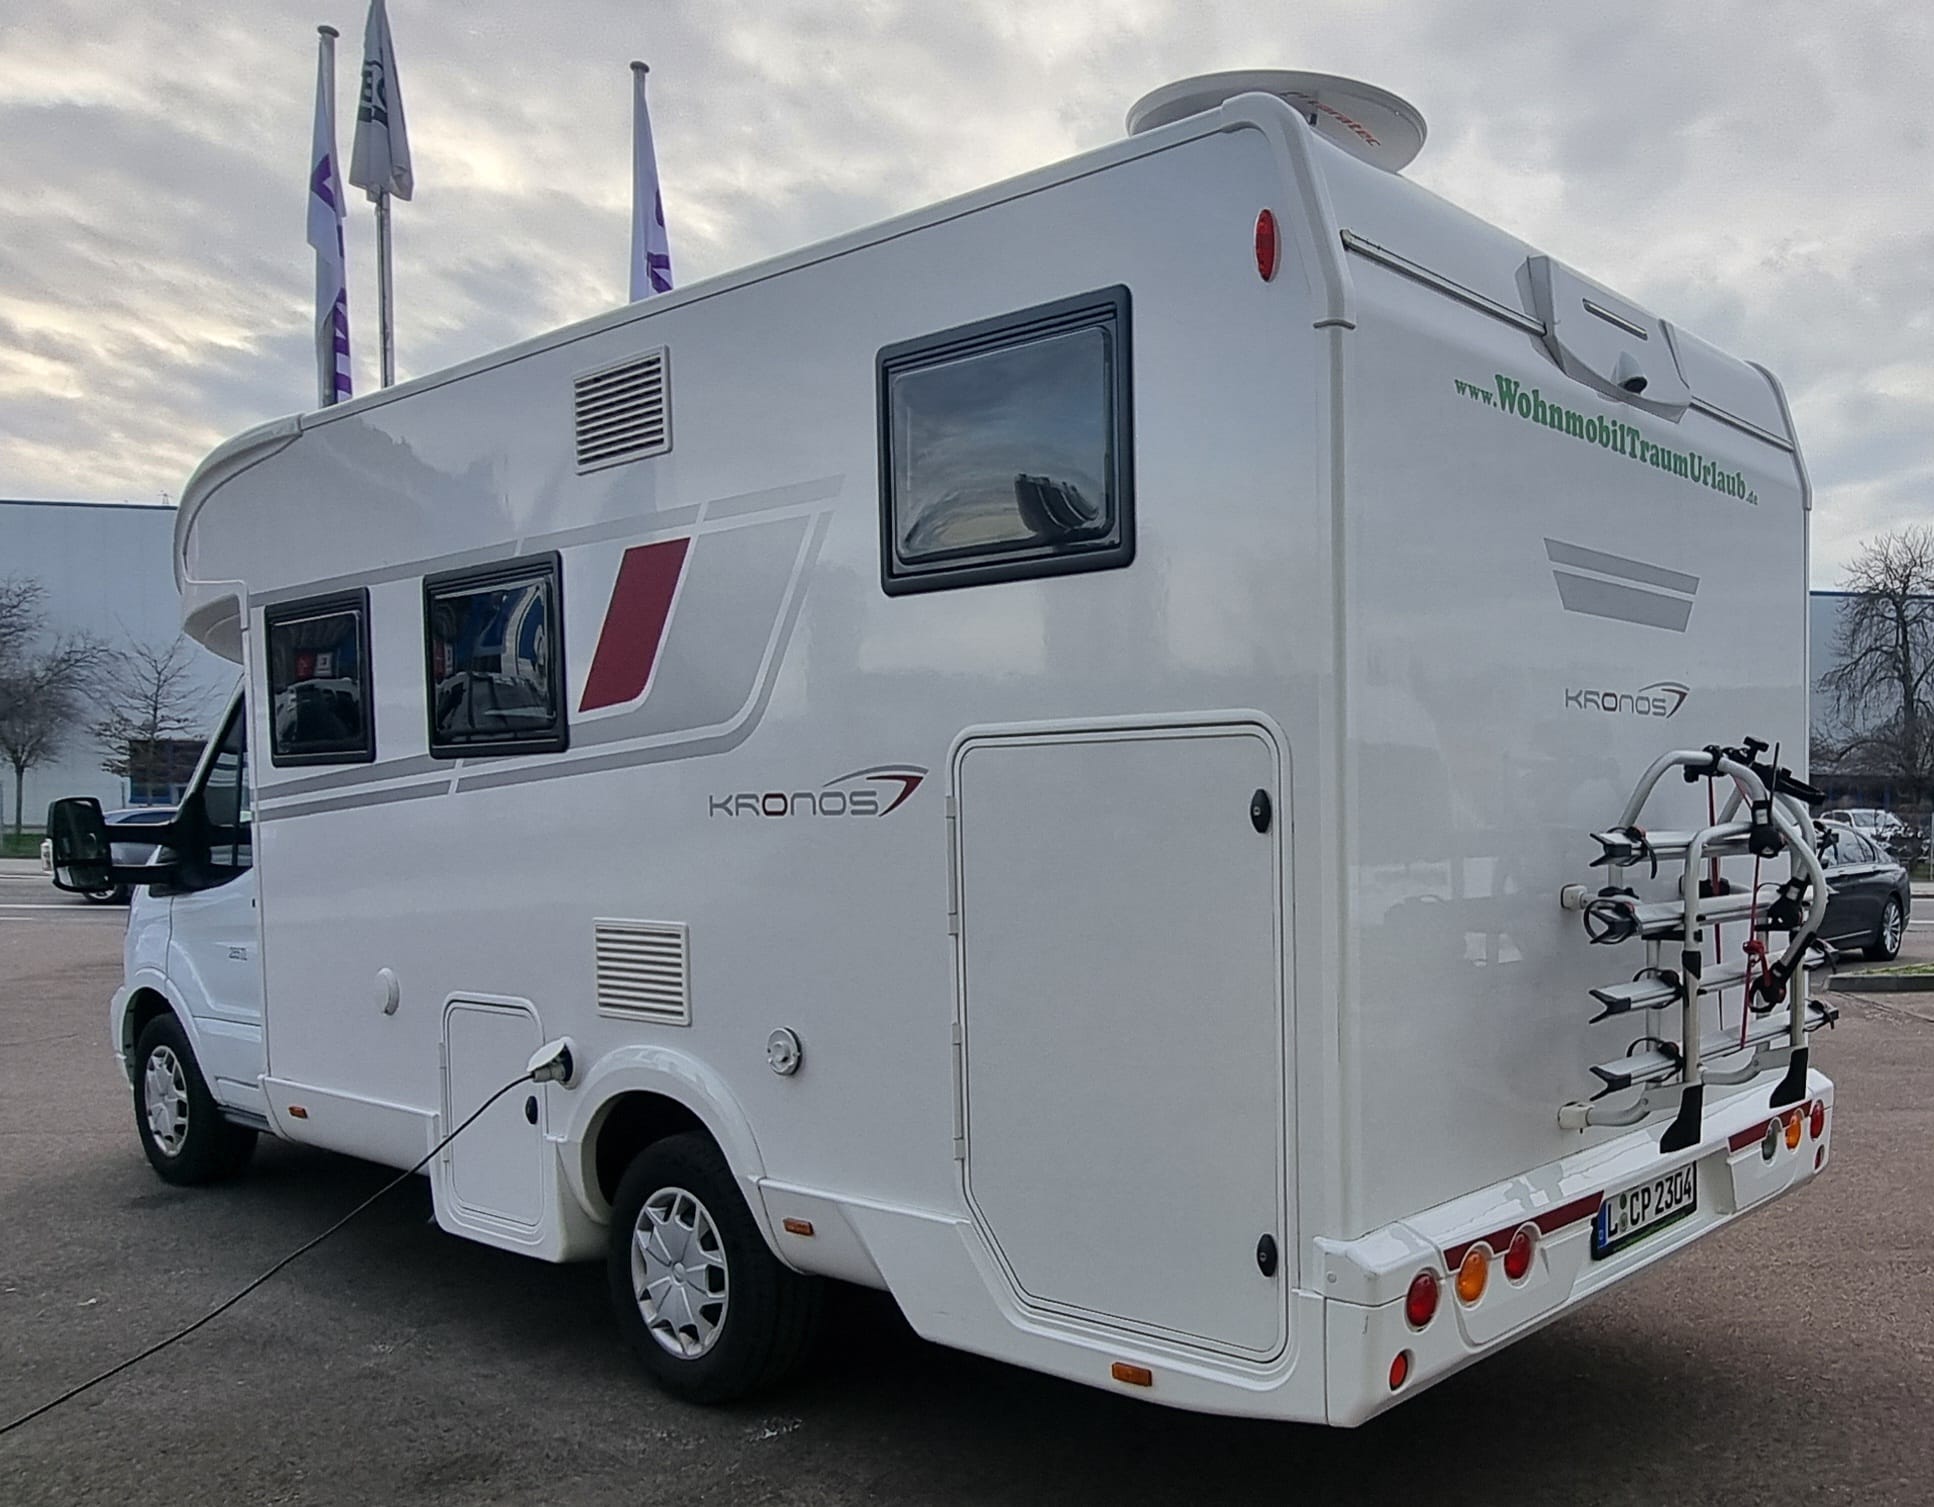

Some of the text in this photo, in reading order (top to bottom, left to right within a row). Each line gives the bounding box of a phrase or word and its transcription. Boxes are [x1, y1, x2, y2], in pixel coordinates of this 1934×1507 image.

[1565, 688, 1667, 717] KRONOS
[709, 791, 879, 817] KRONOS
[1608, 1166, 1691, 1238] L CP 2304
